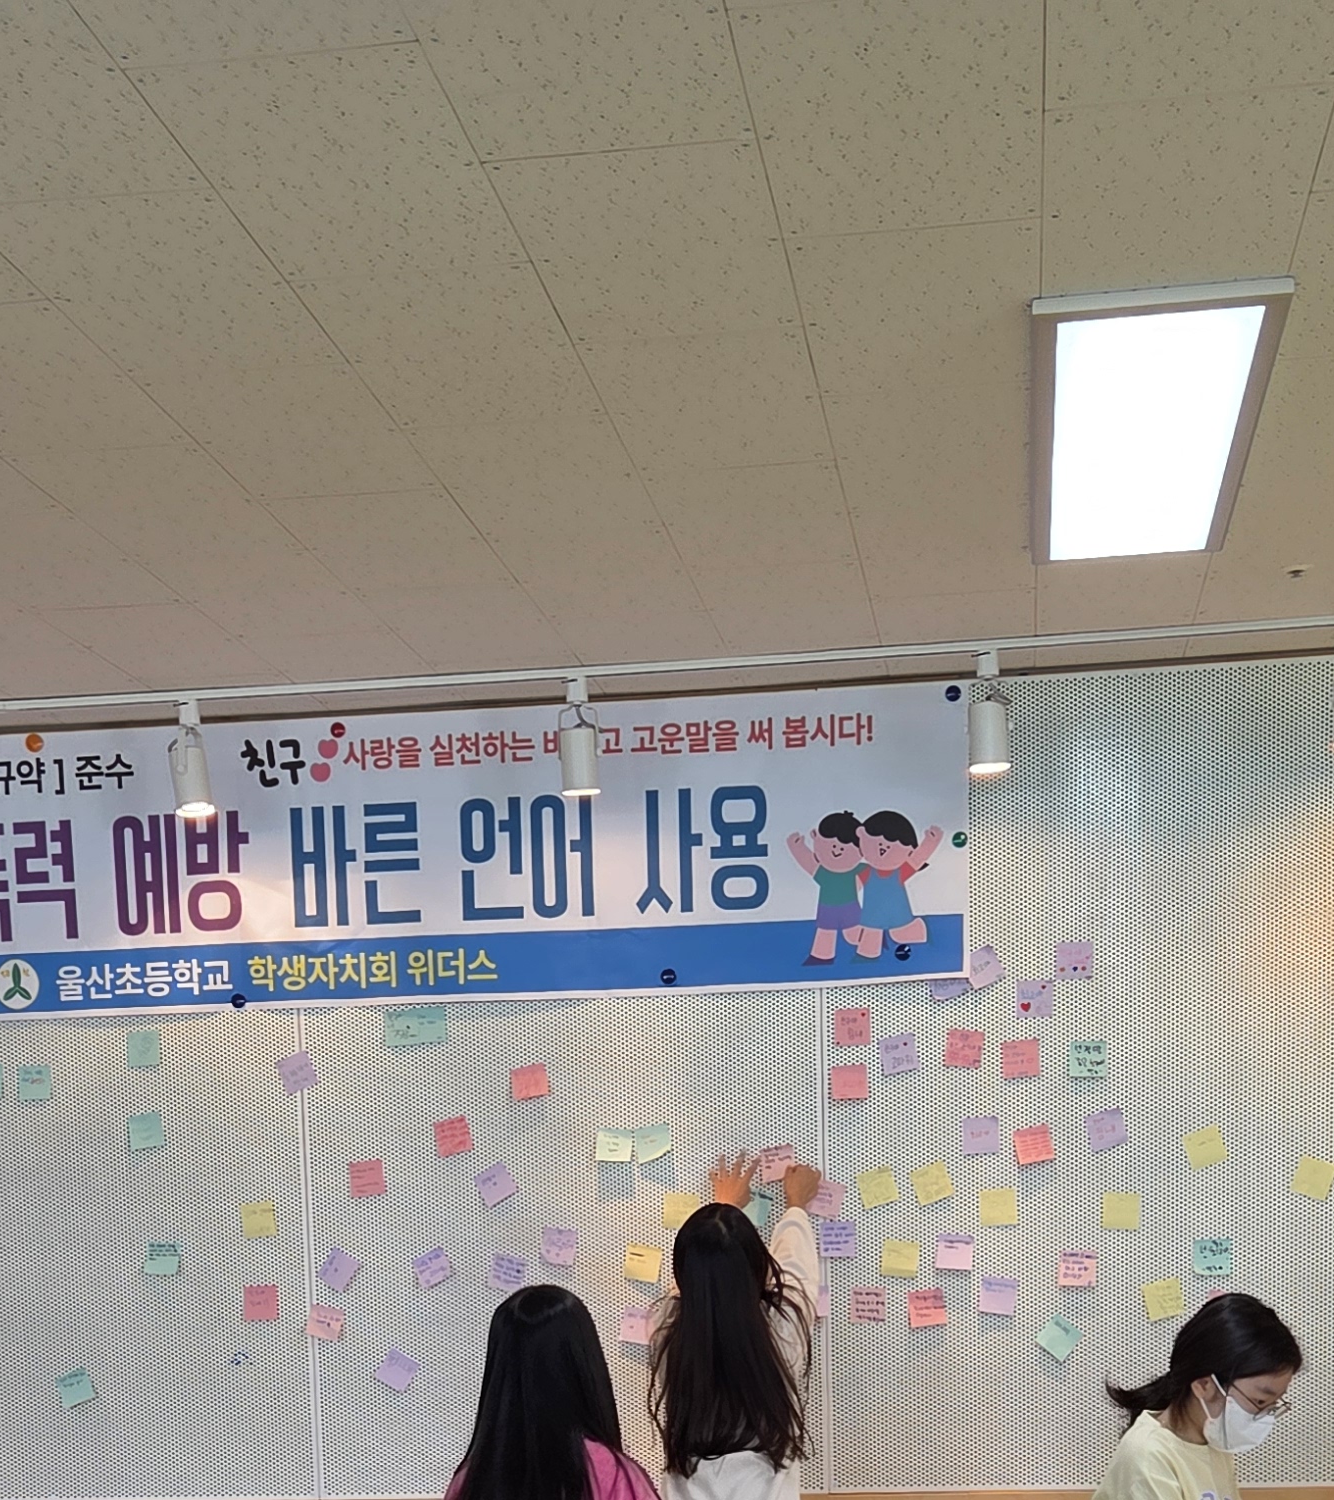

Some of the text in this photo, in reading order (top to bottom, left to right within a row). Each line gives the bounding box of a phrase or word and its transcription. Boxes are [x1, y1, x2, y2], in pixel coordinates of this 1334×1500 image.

[74, 753, 135, 791] 준수
[240, 738, 307, 788] 친구
[342, 736, 423, 771] 사랑을
[429, 730, 536, 767] 실천하는
[630, 719, 740, 755] 고운말을
[746, 716, 773, 751] 써
[781, 712, 874, 749] 봅시다!
[112, 808, 249, 935] 예방
[288, 801, 422, 928] 바른
[460, 794, 596, 921] 언어
[635, 784, 770, 915] 사용
[55, 947, 499, 1002] 울산초등학교 학생자치회 위더스
